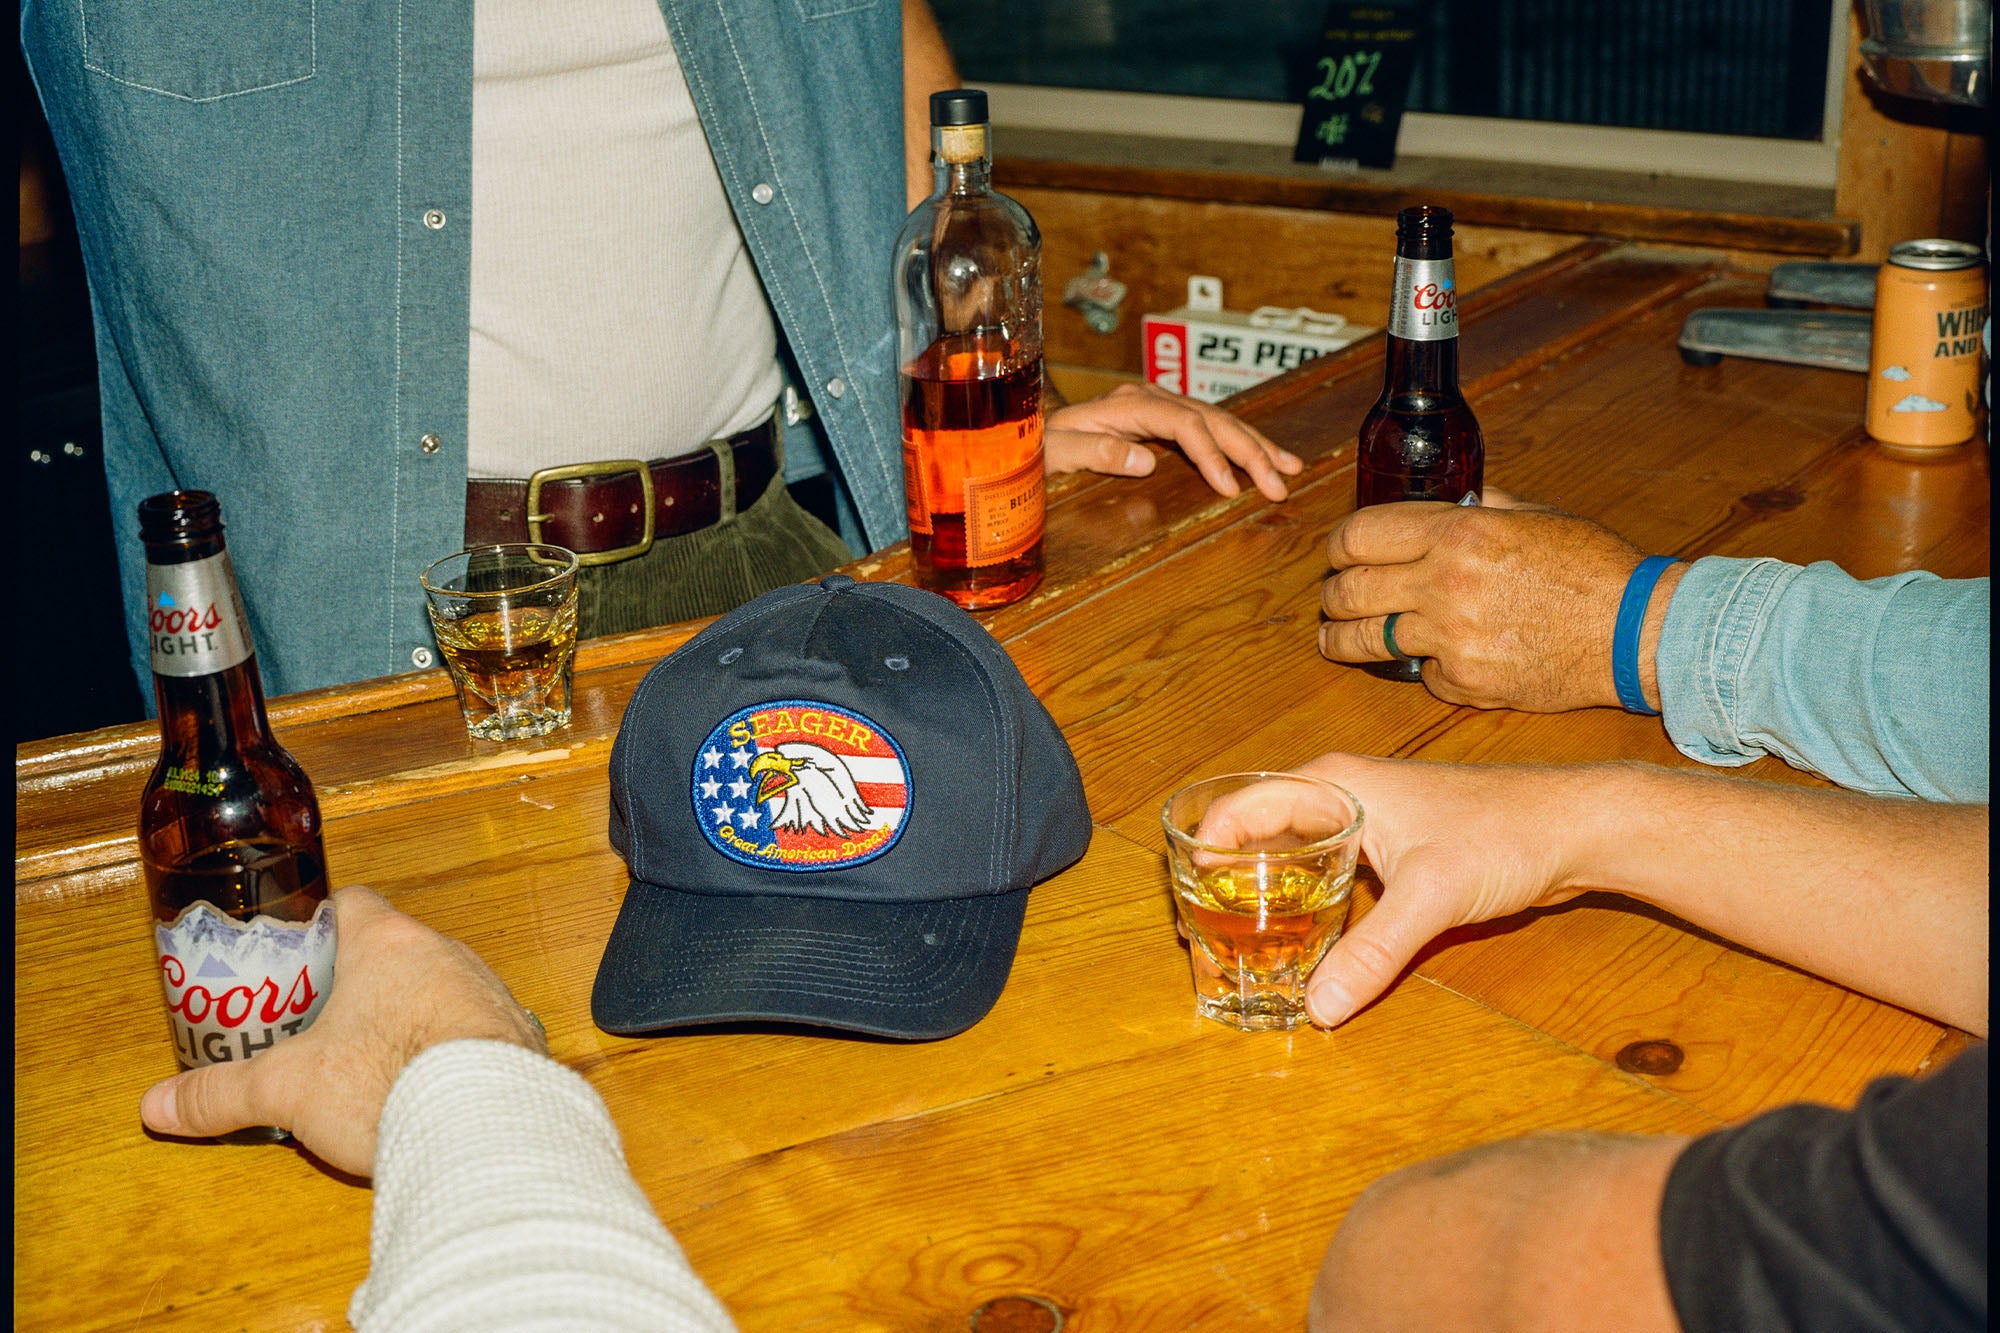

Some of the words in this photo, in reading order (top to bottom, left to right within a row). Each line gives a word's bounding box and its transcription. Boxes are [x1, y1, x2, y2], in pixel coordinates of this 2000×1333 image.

[1308, 51, 1382, 100] 20%
[1414, 283, 1456, 310] Coo
[1422, 309, 1458, 326] LIGH
[1155, 332, 1183, 396] AID
[1198, 332, 1241, 363] 25
[1254, 340, 1325, 370] PER
[1934, 337, 1978, 358] AND
[149, 602, 223, 635] oors
[153, 632, 214, 655] IGHT
[729, 711, 872, 752] SEAGER
[718, 825, 757, 855] Great
[757, 843, 837, 860] American
[841, 822, 892, 857] Dream
[161, 954, 319, 1028] Coors
